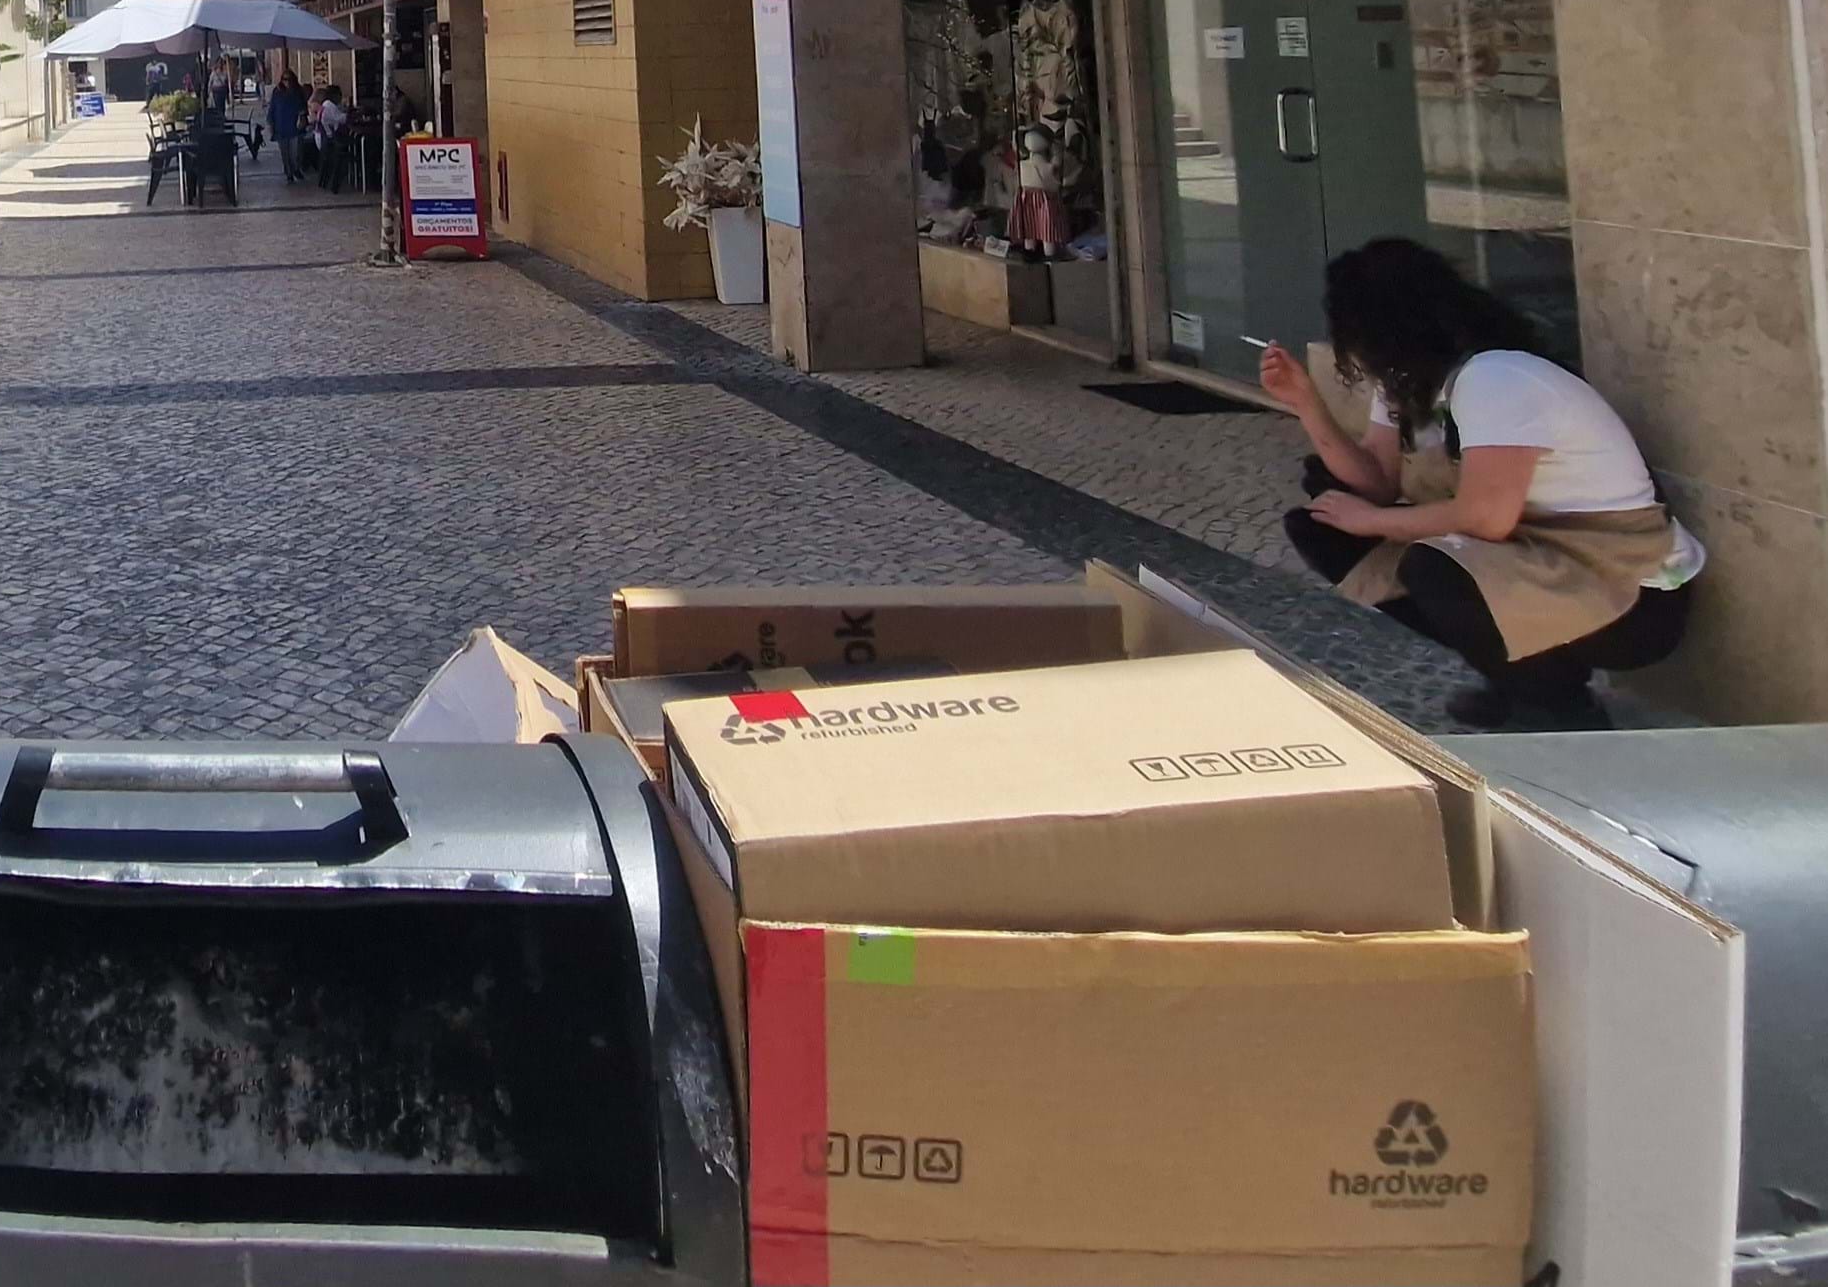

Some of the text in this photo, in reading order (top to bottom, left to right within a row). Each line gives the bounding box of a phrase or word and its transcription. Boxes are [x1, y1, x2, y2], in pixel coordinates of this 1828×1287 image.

[419, 148, 460, 164] MPC
[417, 225, 474, 233] GRATUITOS!
[800, 723, 918, 741] refurbished
[1329, 1169, 1489, 1196] hardware
